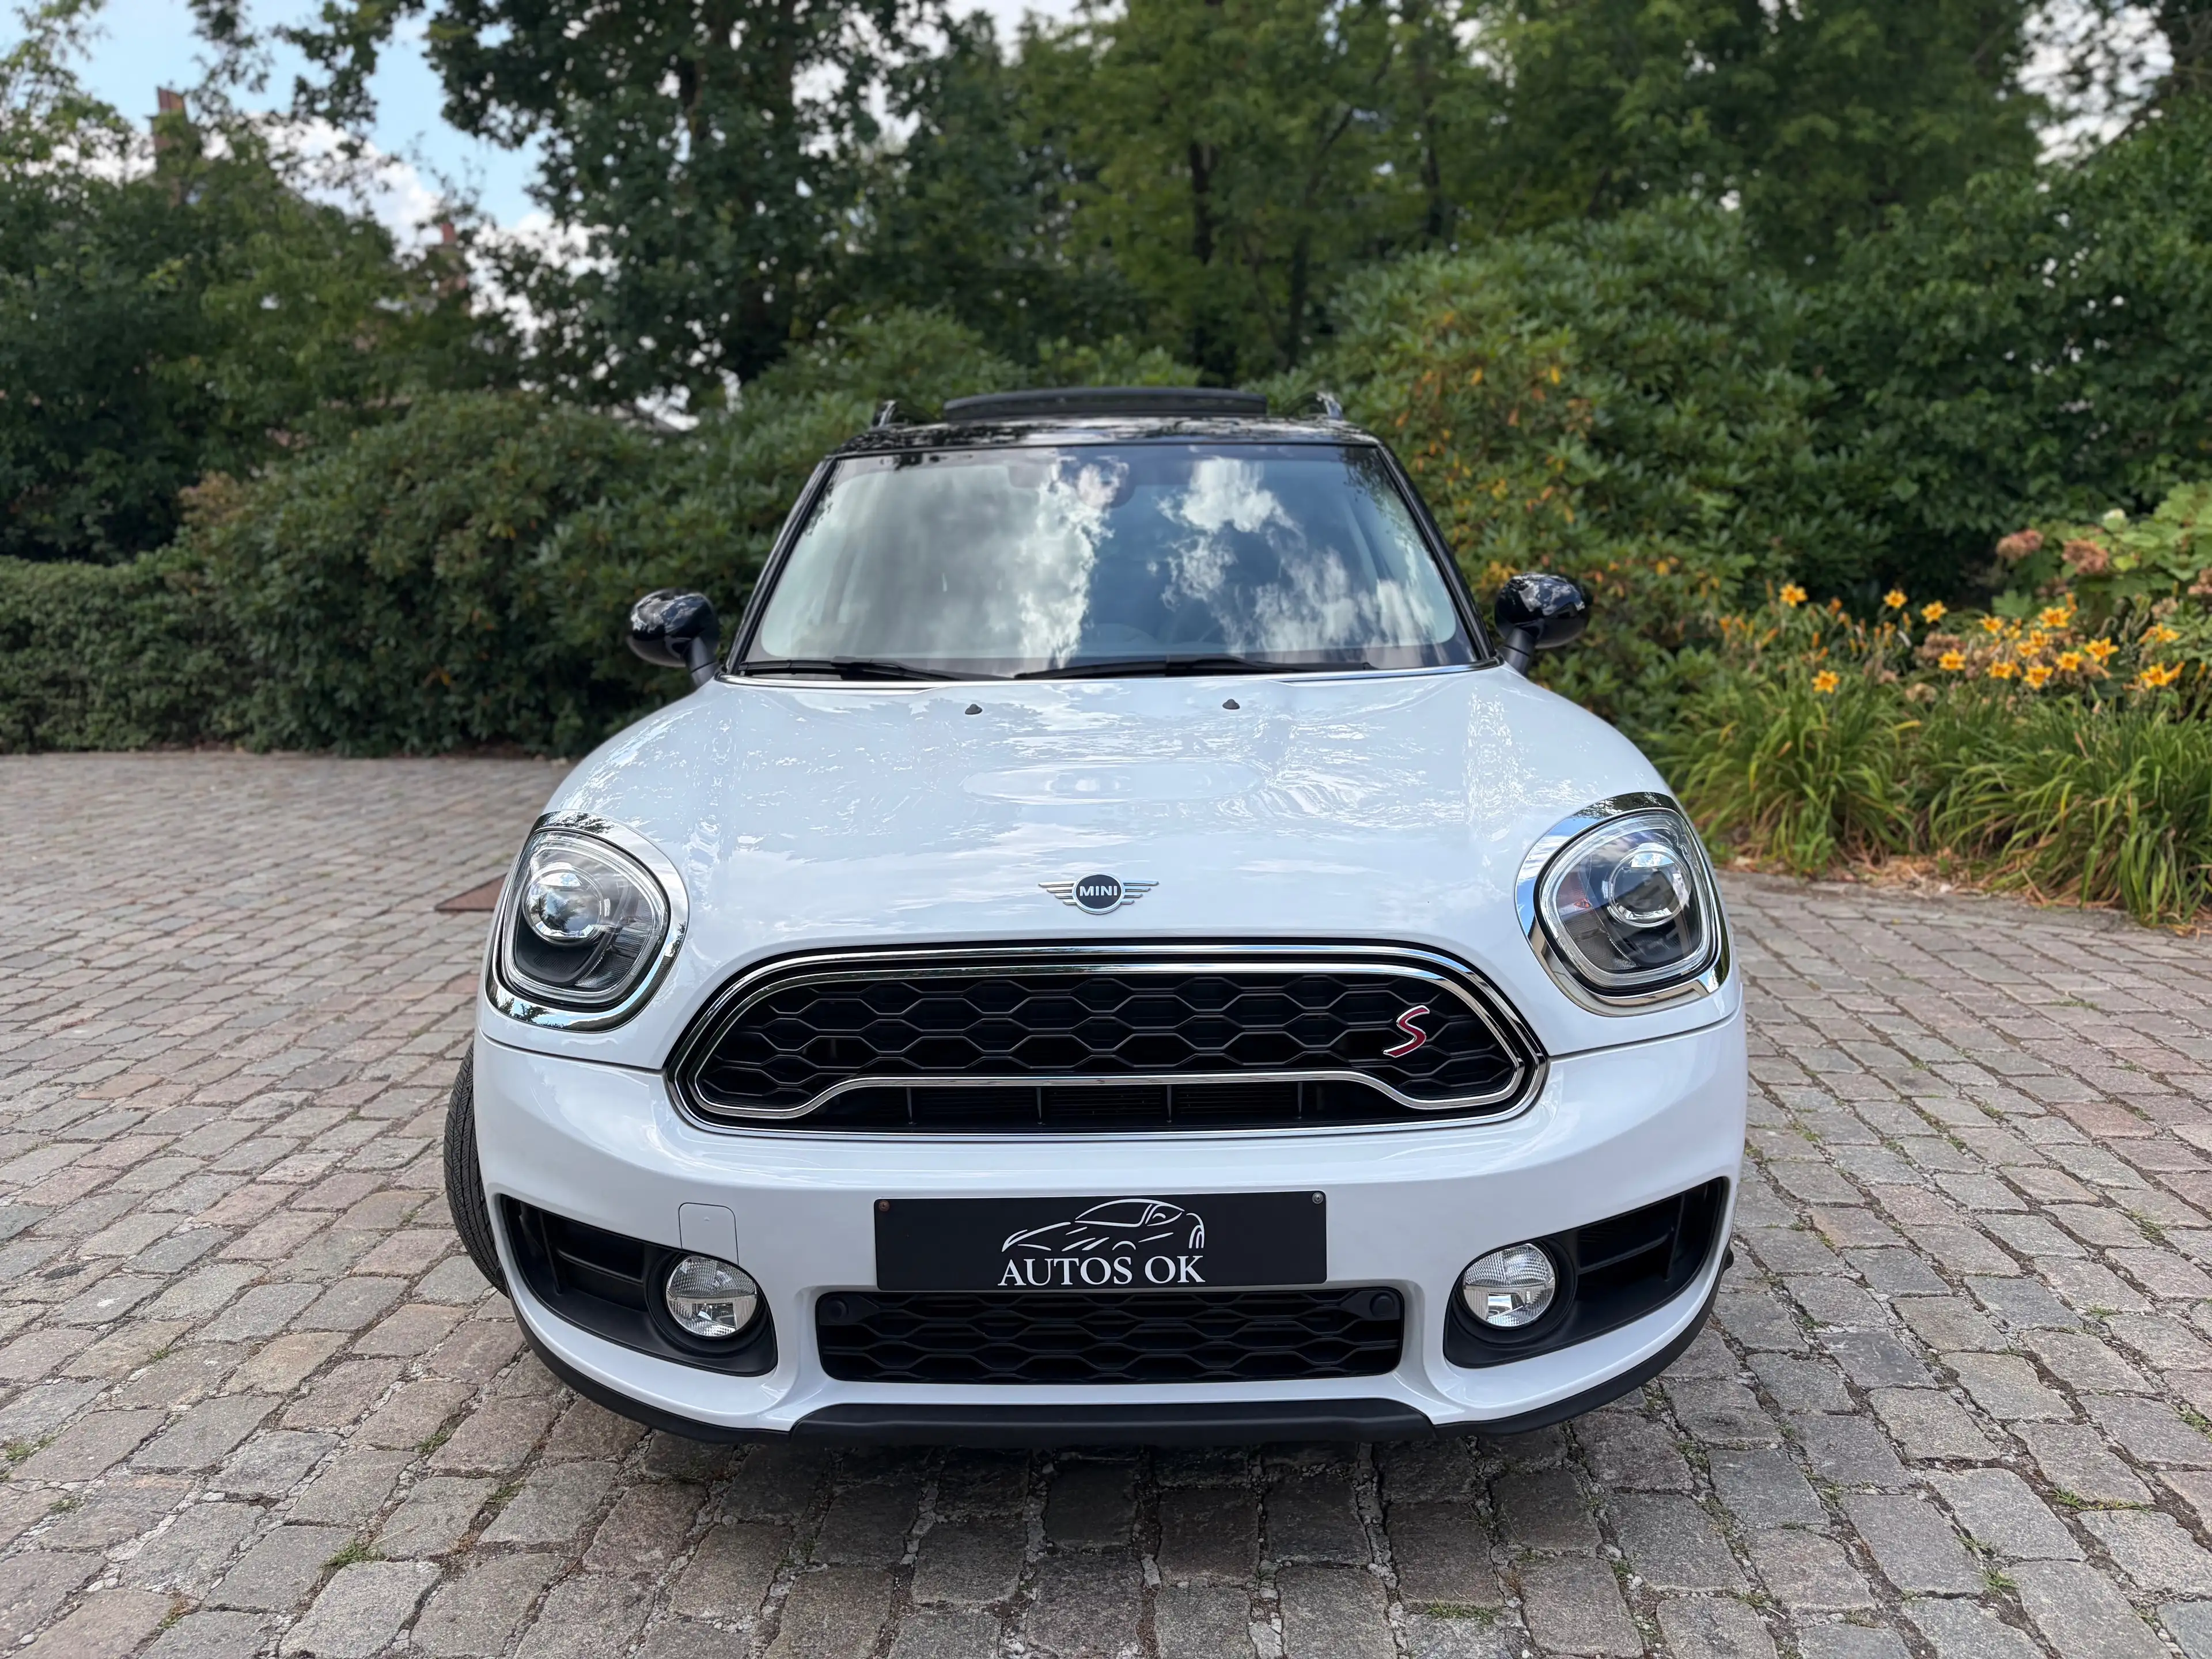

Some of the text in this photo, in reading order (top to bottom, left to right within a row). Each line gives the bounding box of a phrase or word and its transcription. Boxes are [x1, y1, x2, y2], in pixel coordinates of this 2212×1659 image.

[1080, 885, 1118, 896] MINI
[1383, 1005, 1430, 1058] S
[997, 1255, 1206, 1287] AUTOS OK
